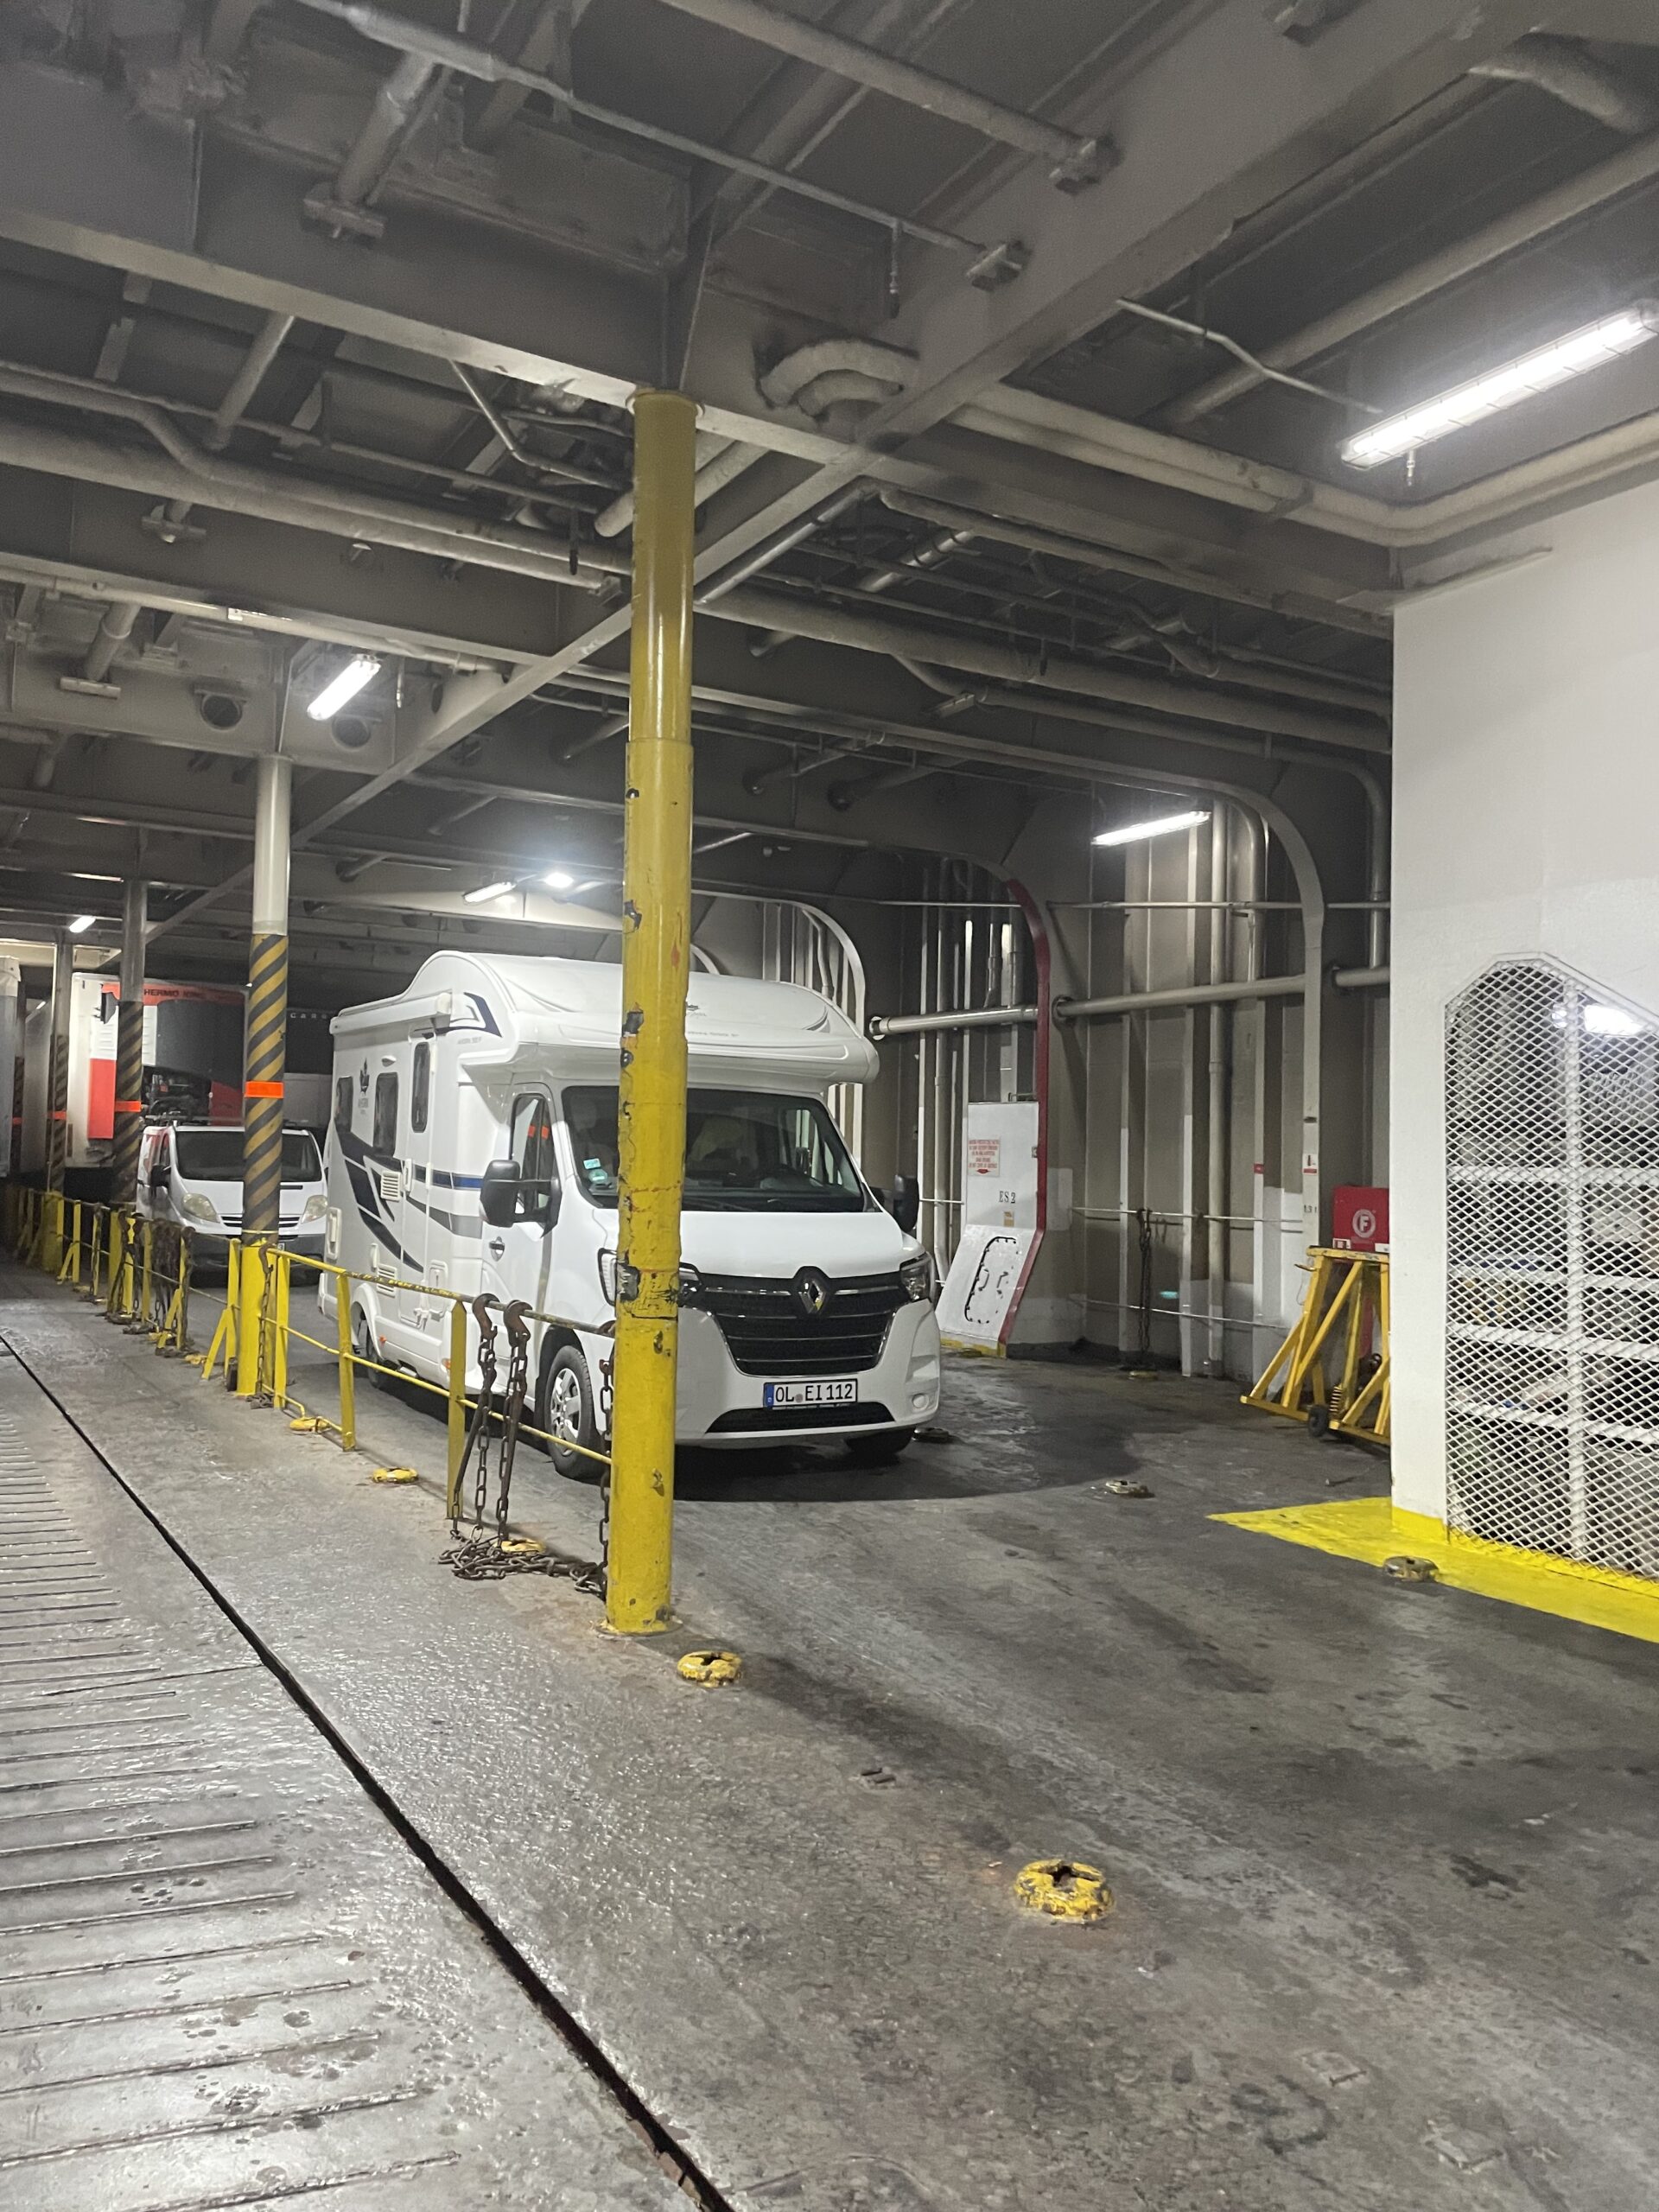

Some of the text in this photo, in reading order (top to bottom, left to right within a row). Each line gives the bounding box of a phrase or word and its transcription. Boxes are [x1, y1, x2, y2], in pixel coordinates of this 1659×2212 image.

[143, 988, 180, 997] HERMO
[999, 1191, 1016, 1204] ES 2
[775, 1383, 853, 1402] OL EI 112
